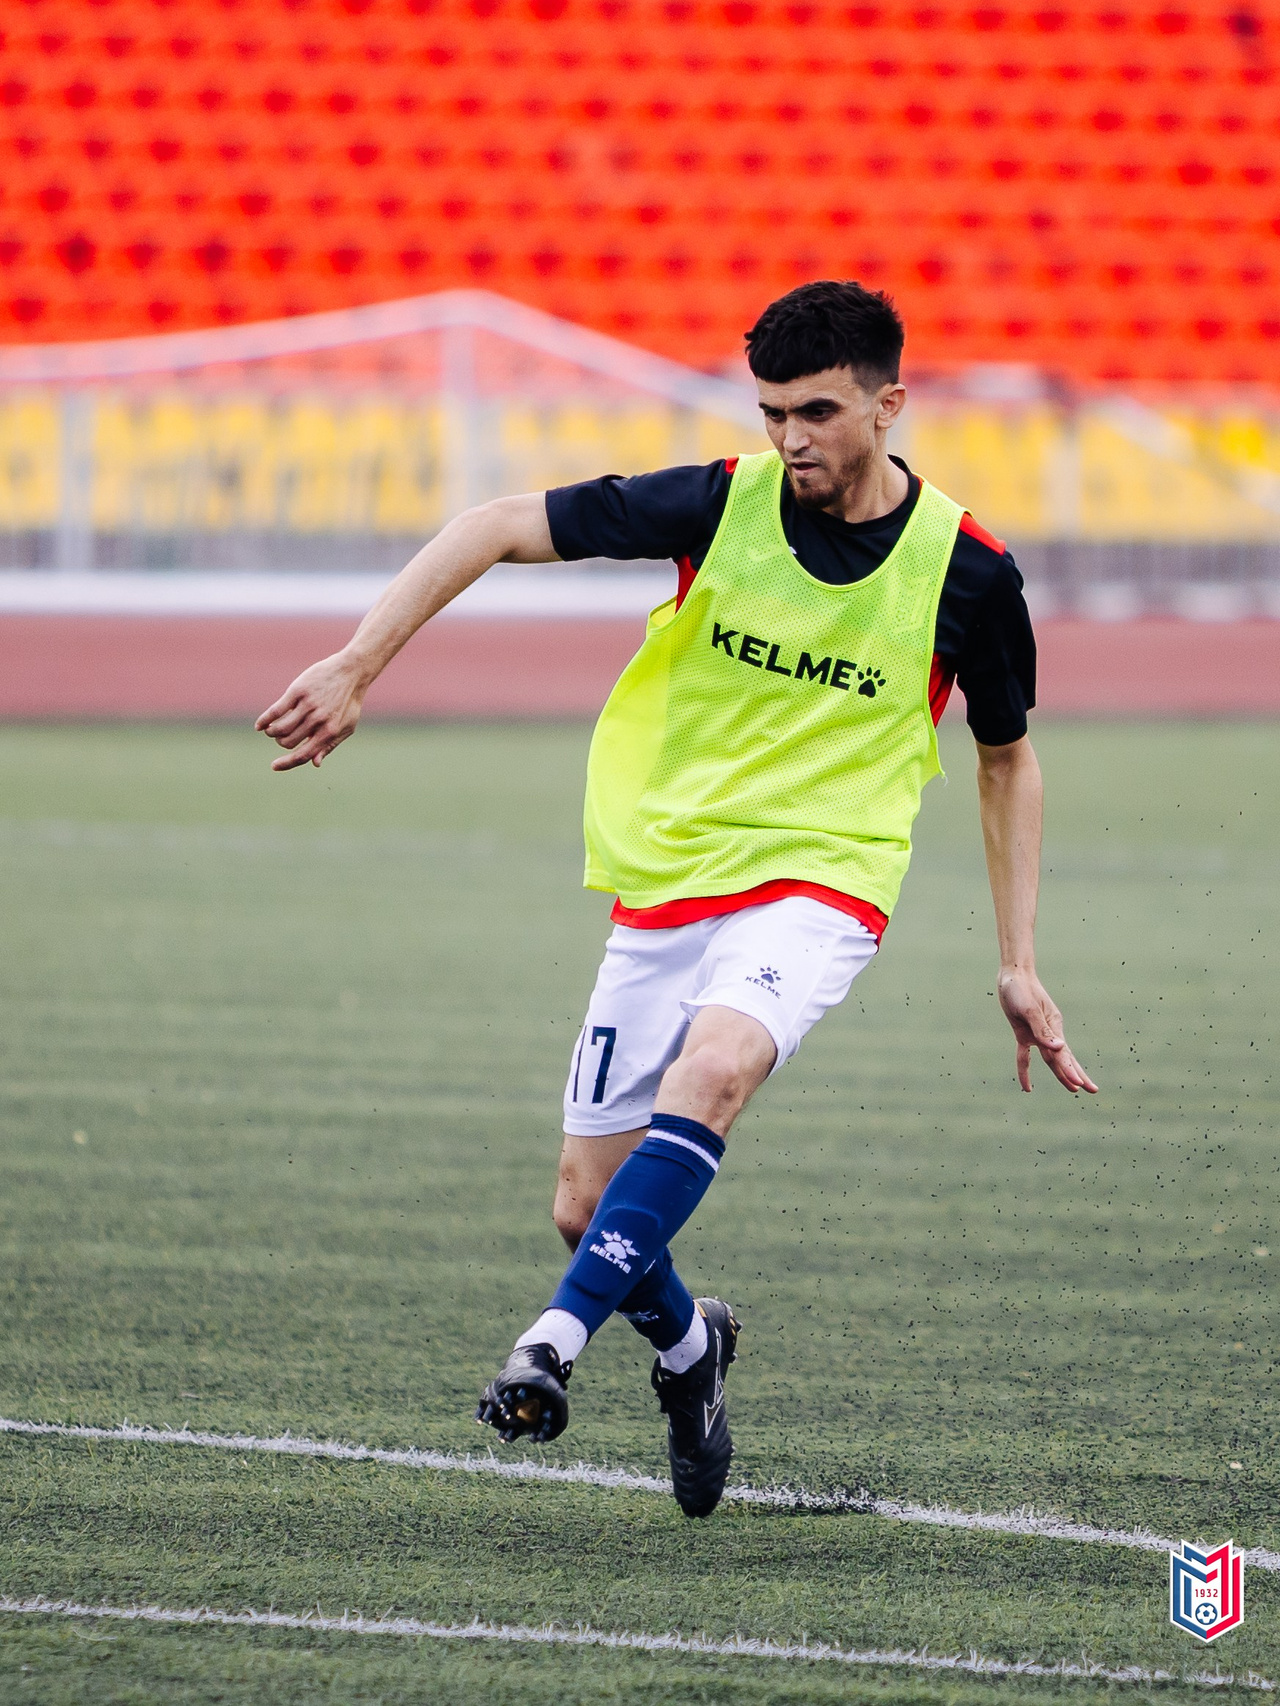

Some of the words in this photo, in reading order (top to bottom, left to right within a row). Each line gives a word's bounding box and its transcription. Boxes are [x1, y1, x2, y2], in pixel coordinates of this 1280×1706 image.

[711, 622, 858, 691] KELME
[745, 976, 782, 1000] KELME
[572, 1025, 617, 1104] 17
[589, 1243, 632, 1274] KELME
